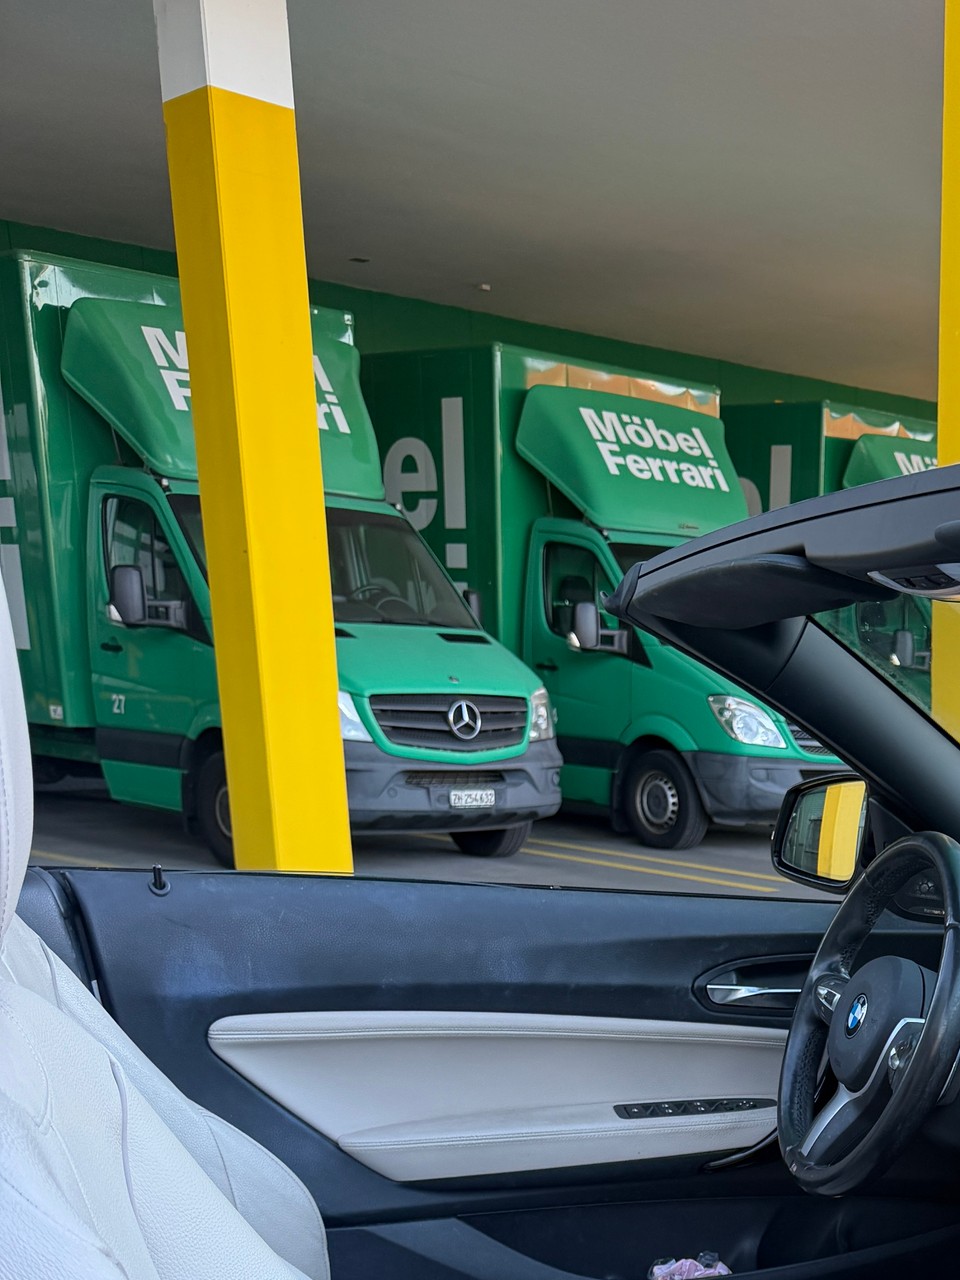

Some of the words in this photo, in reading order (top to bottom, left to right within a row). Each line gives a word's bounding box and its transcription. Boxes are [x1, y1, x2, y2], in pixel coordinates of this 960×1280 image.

[579, 407, 714, 459] Möbel
[596, 441, 730, 493] Ferrari
[112, 694, 126, 714] 27
